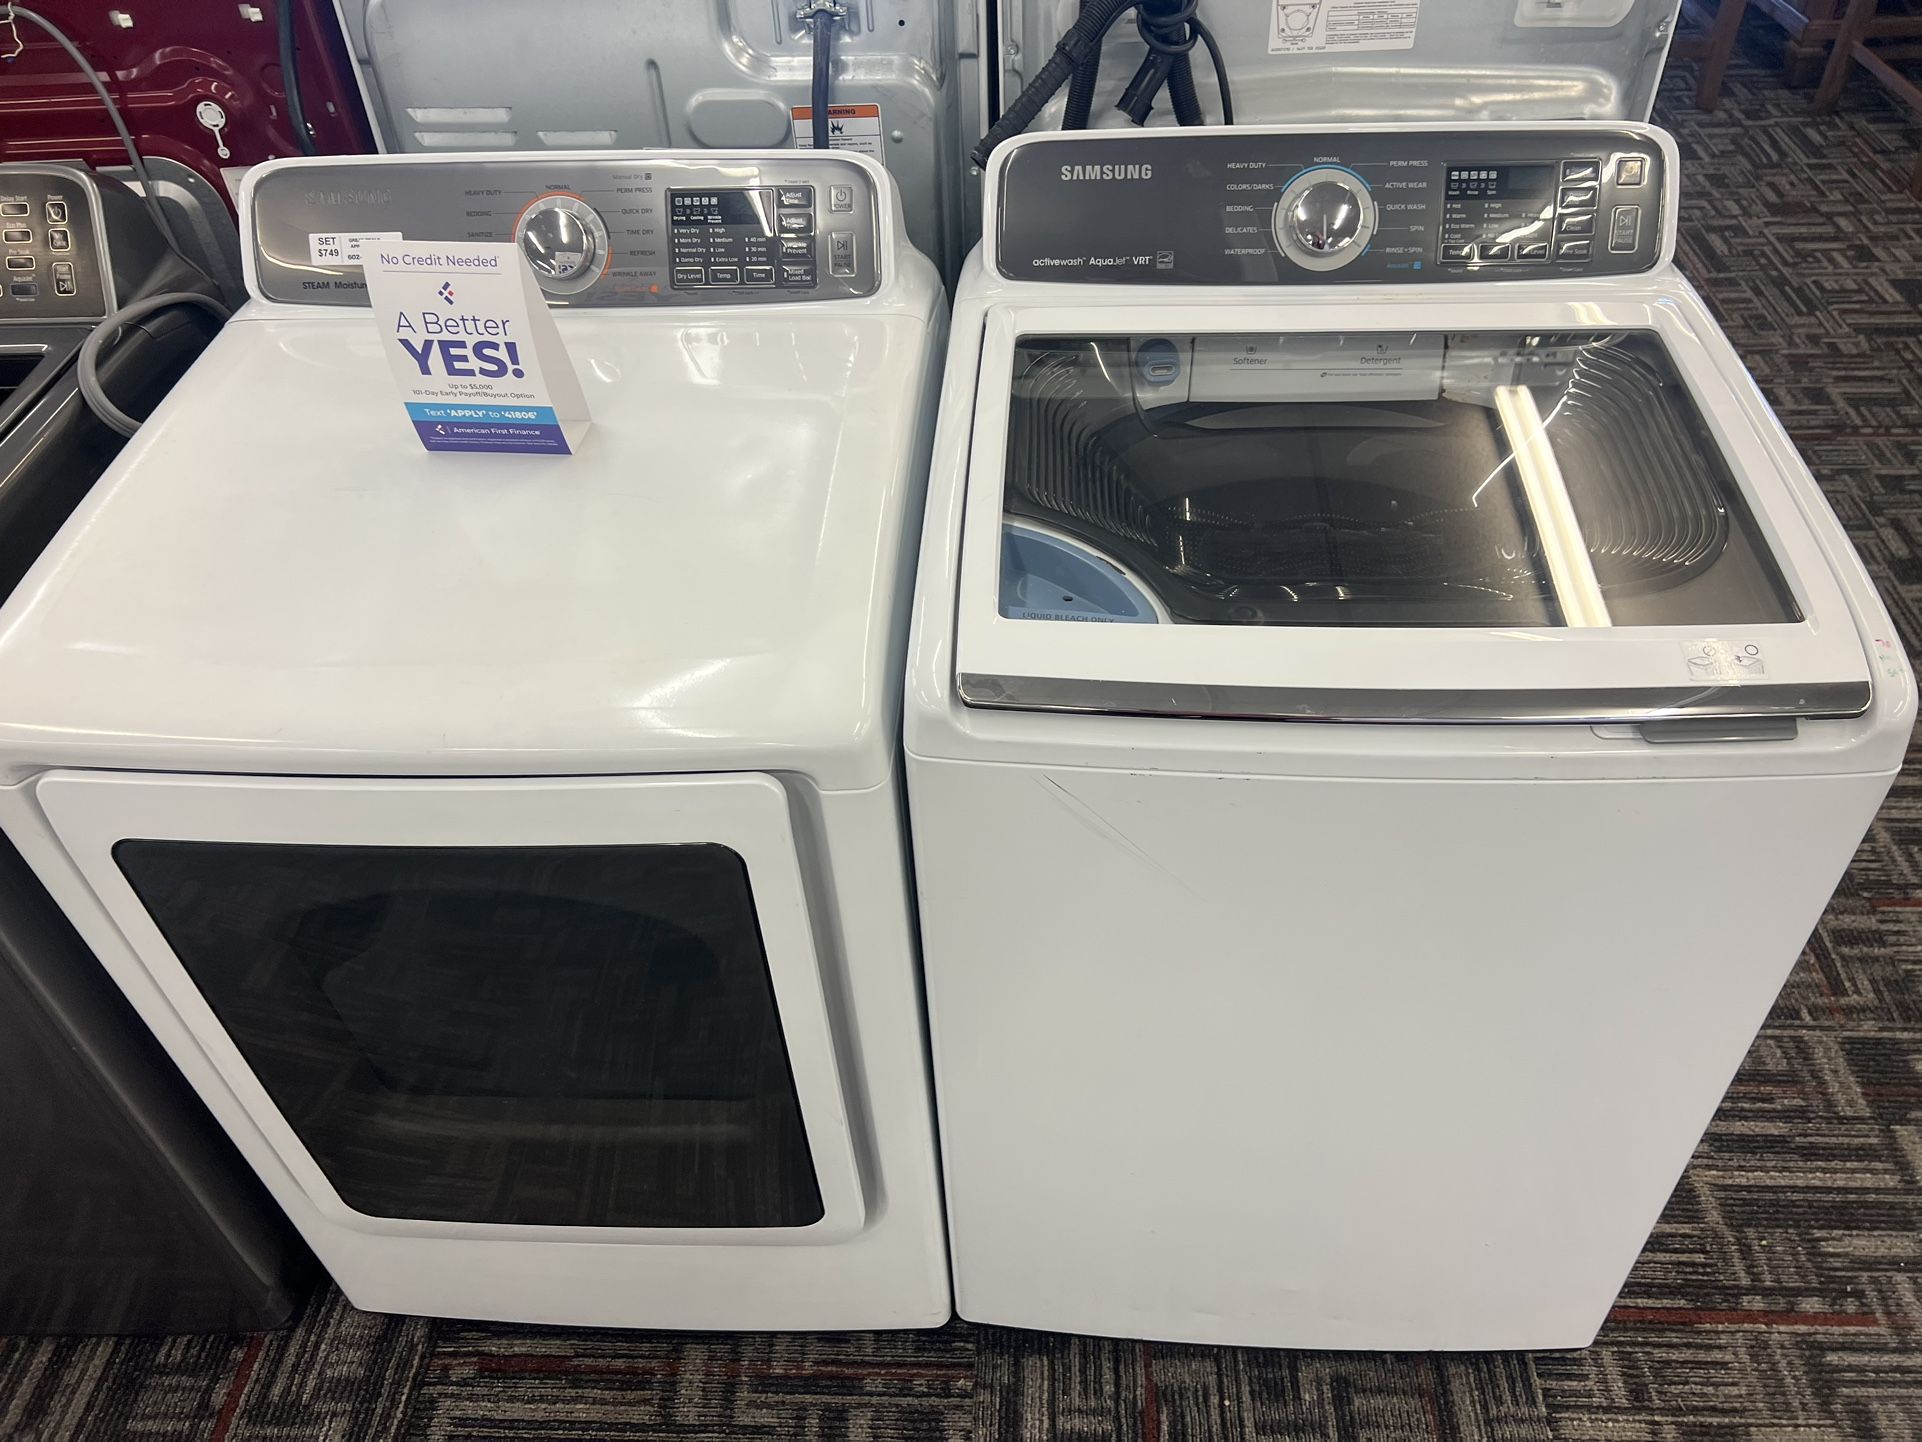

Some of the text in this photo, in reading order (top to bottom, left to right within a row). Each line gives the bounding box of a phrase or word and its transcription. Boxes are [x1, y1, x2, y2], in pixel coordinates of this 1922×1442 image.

[1061, 164, 1152, 180] SAMSUNG
[318, 237, 336, 246] SET
[318, 248, 340, 258] $749
[380, 253, 499, 268] No Credit Needed
[302, 281, 368, 290] STEAM Moistur
[396, 311, 510, 336] A Better
[398, 338, 525, 379] YES!
[1232, 357, 1268, 366] Softener
[1360, 356, 1402, 366] Detergent
[440, 390, 458, 398] Early
[459, 390, 509, 398] Payoff/Buyout
[510, 392, 535, 400] Option
[424, 408, 446, 417] Text
[488, 410, 500, 418] to
[454, 426, 490, 434] American
